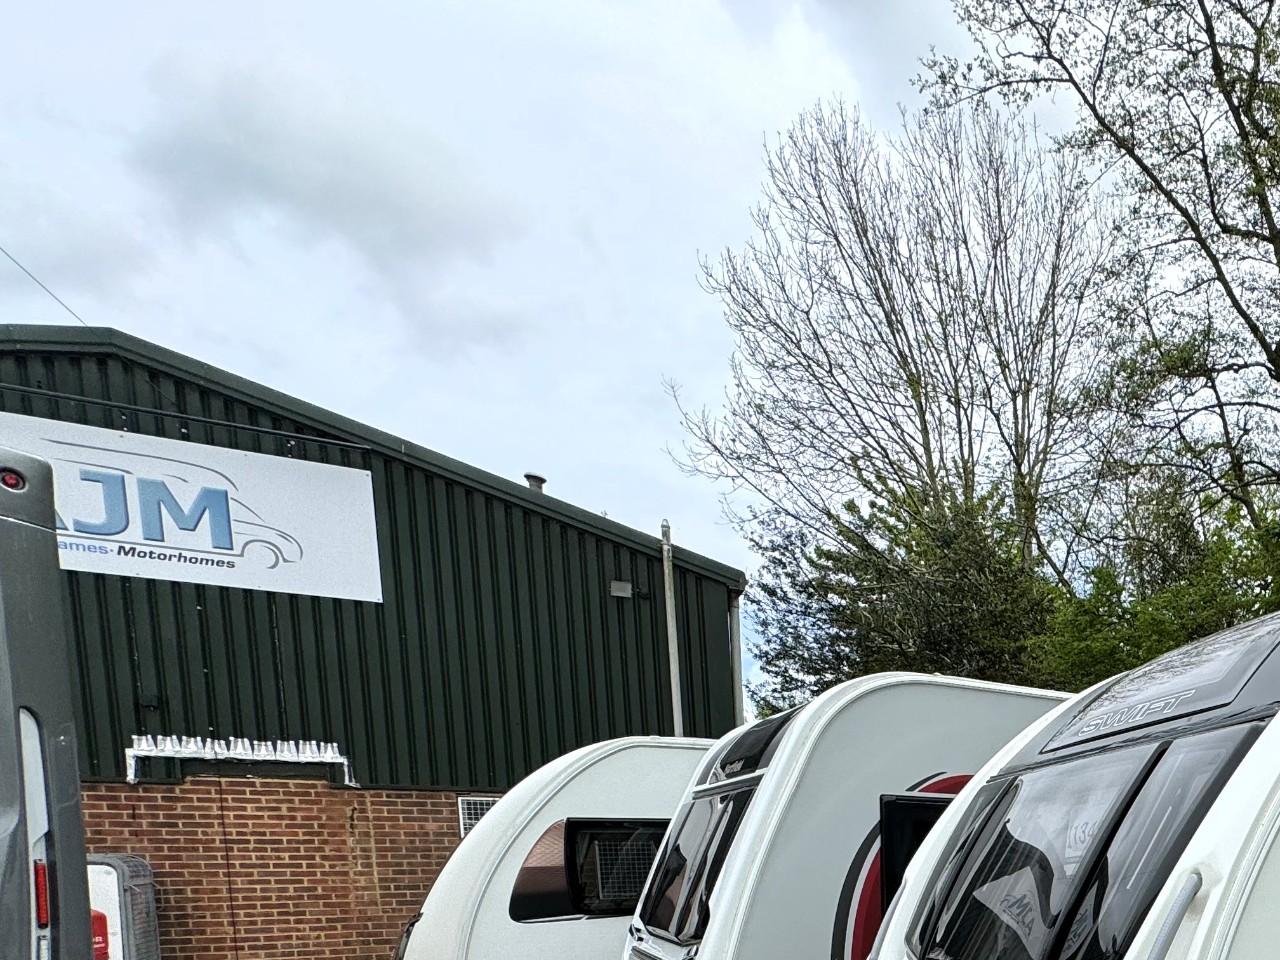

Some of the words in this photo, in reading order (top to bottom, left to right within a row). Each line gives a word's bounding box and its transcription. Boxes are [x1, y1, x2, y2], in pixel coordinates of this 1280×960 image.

[56, 469, 234, 550] JM
[58, 540, 109, 555] ames
[117, 545, 236, 569] Motorhomes
[1079, 690, 1196, 736] SWIFT
